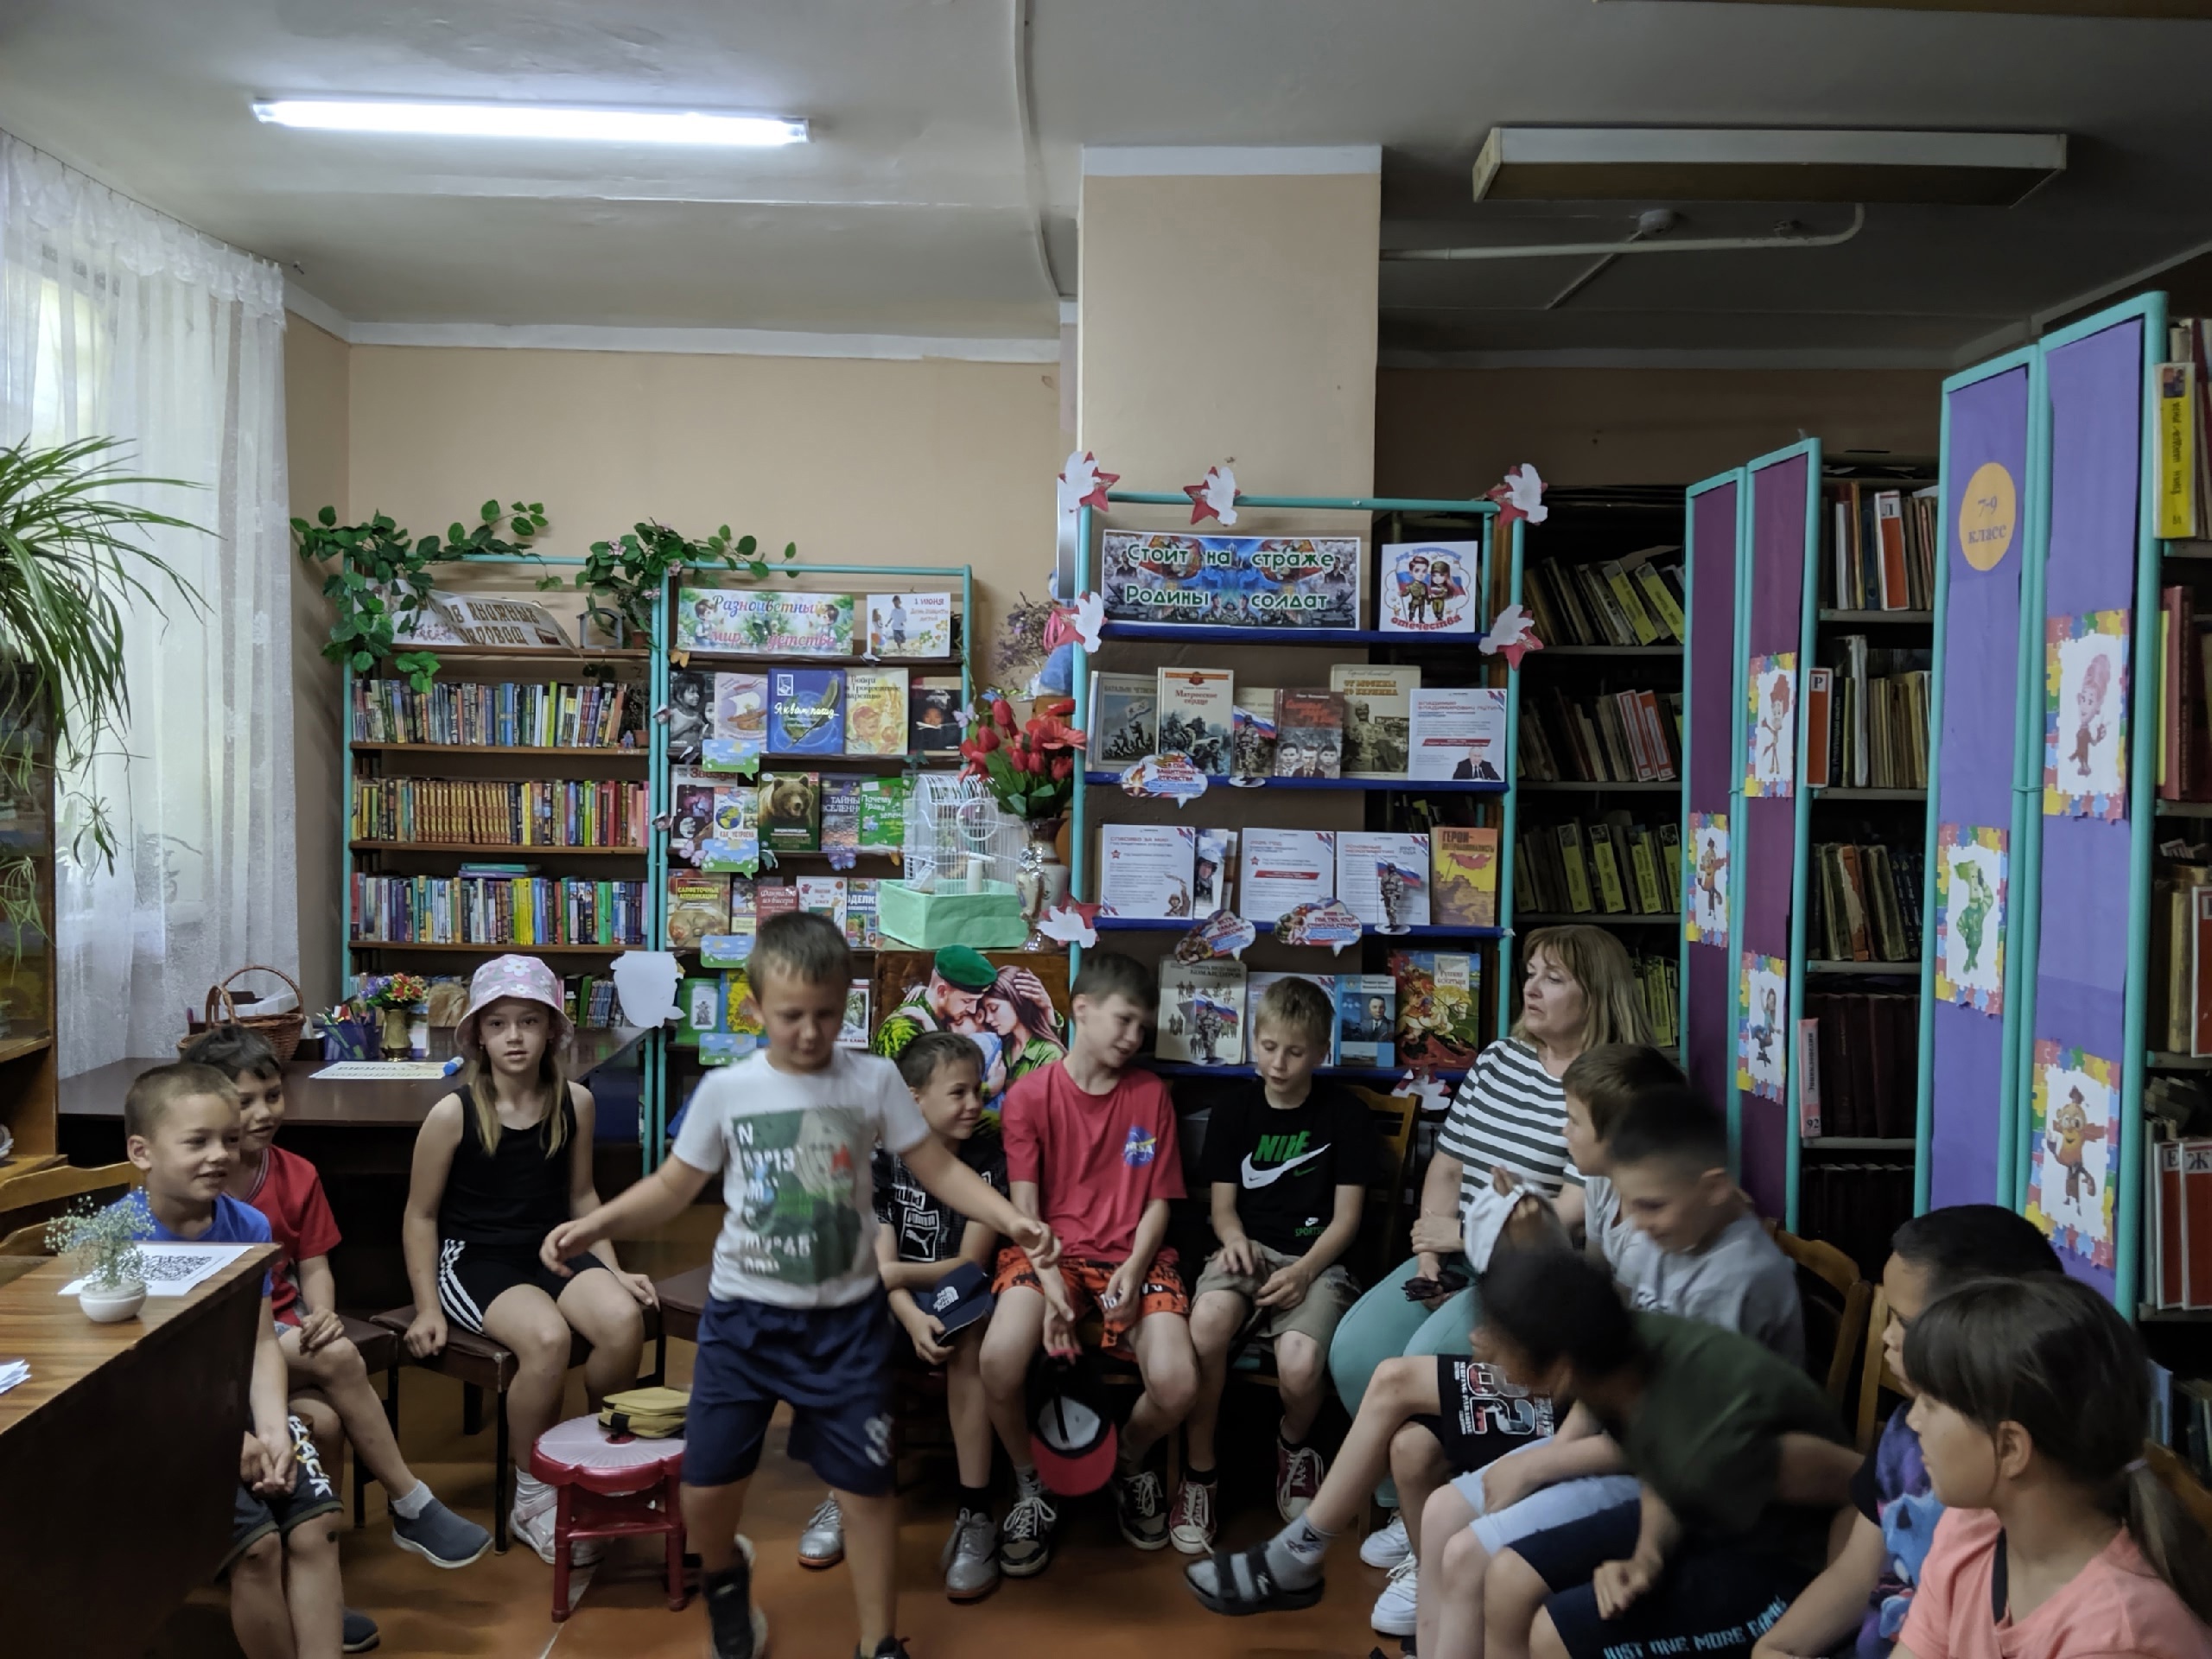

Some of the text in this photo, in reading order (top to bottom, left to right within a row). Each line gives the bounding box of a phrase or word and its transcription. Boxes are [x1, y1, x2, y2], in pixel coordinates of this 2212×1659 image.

[1126, 543, 1335, 570] Стоит на страже
[712, 594, 827, 617] Разноцветный
[1125, 584, 1328, 612] Родины солдат
[710, 629, 836, 652] мир детства
[861, 794, 893, 806] Почему
[865, 802, 886, 812] трава
[2186, 1151, 2210, 1170] Ж
[1648, 1636, 1690, 1656] ONE
[1692, 1625, 1747, 1652] MORE
